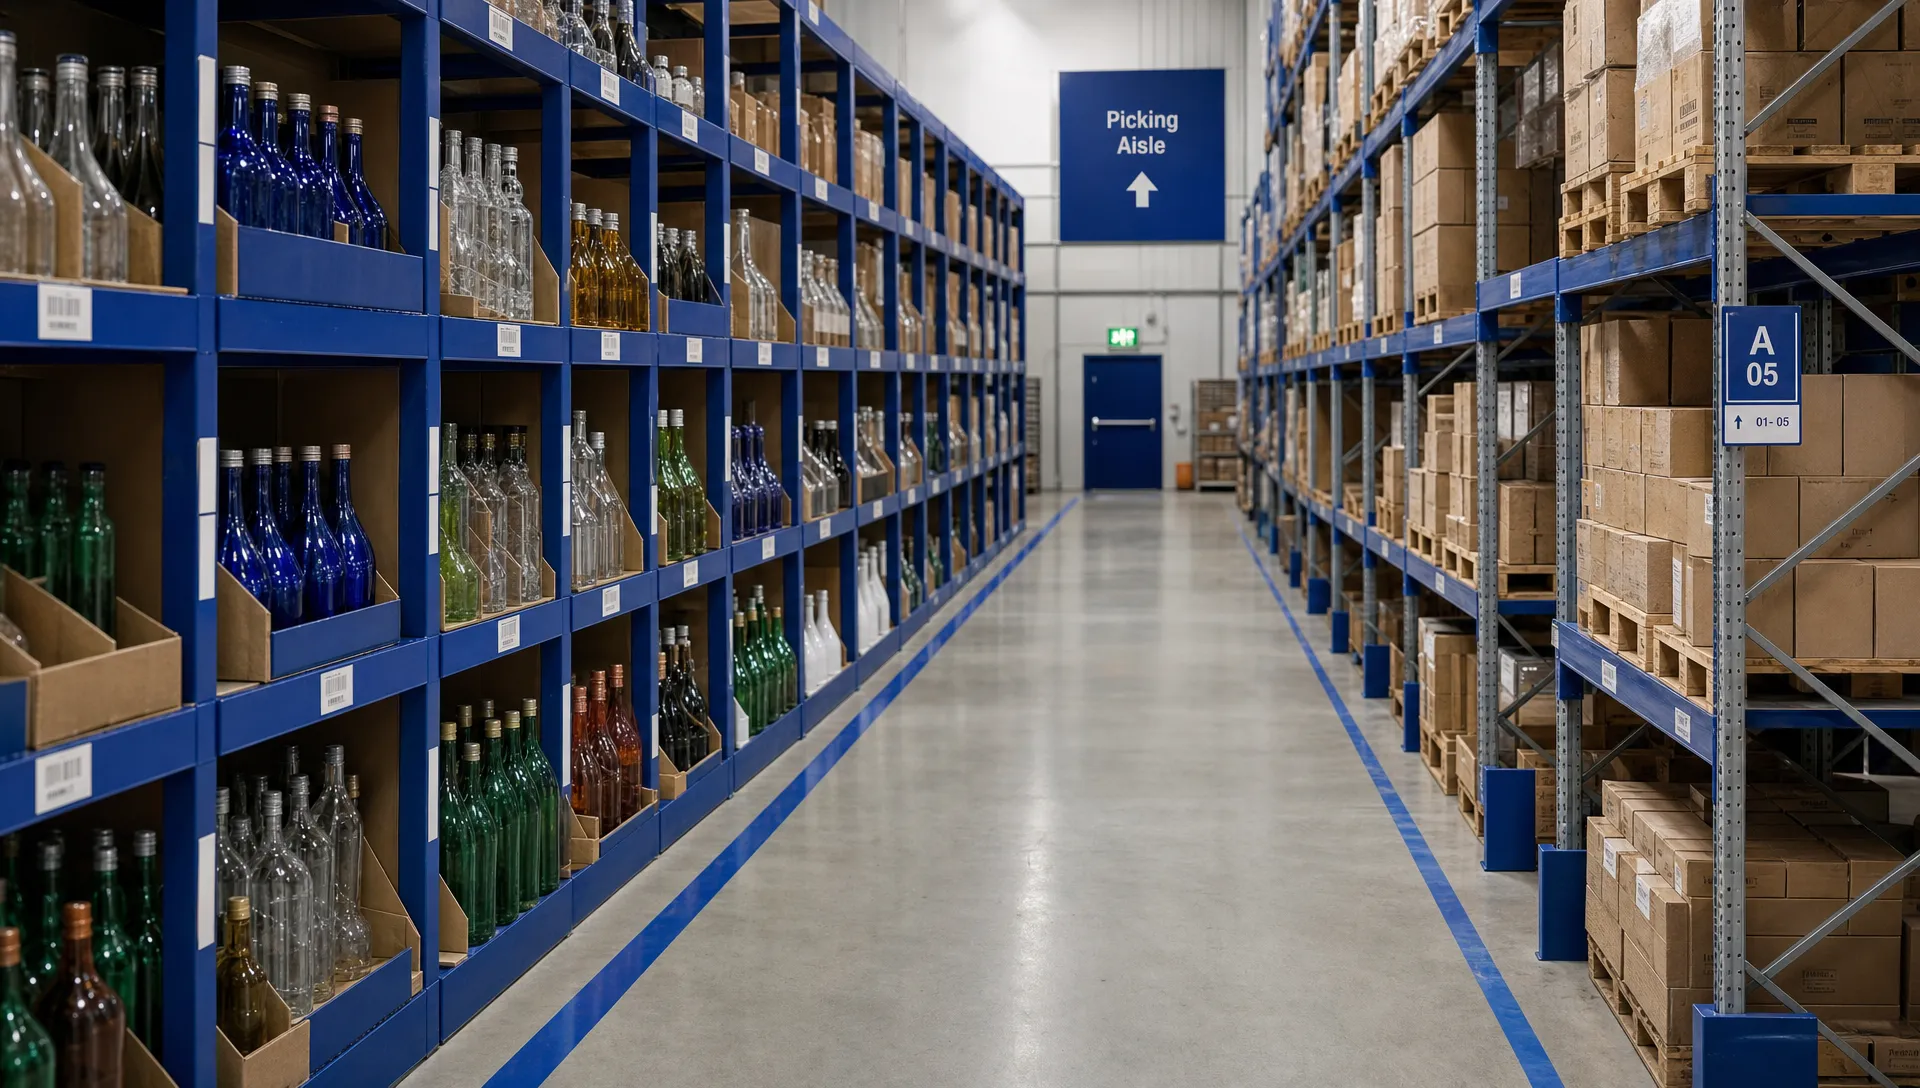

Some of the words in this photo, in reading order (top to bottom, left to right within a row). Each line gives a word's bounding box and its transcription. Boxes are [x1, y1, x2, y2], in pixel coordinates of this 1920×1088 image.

[1106, 110, 1179, 133] Picking
[1116, 135, 1166, 155] Aisle
[1749, 325, 1775, 356] A
[1746, 362, 1779, 387] 05
